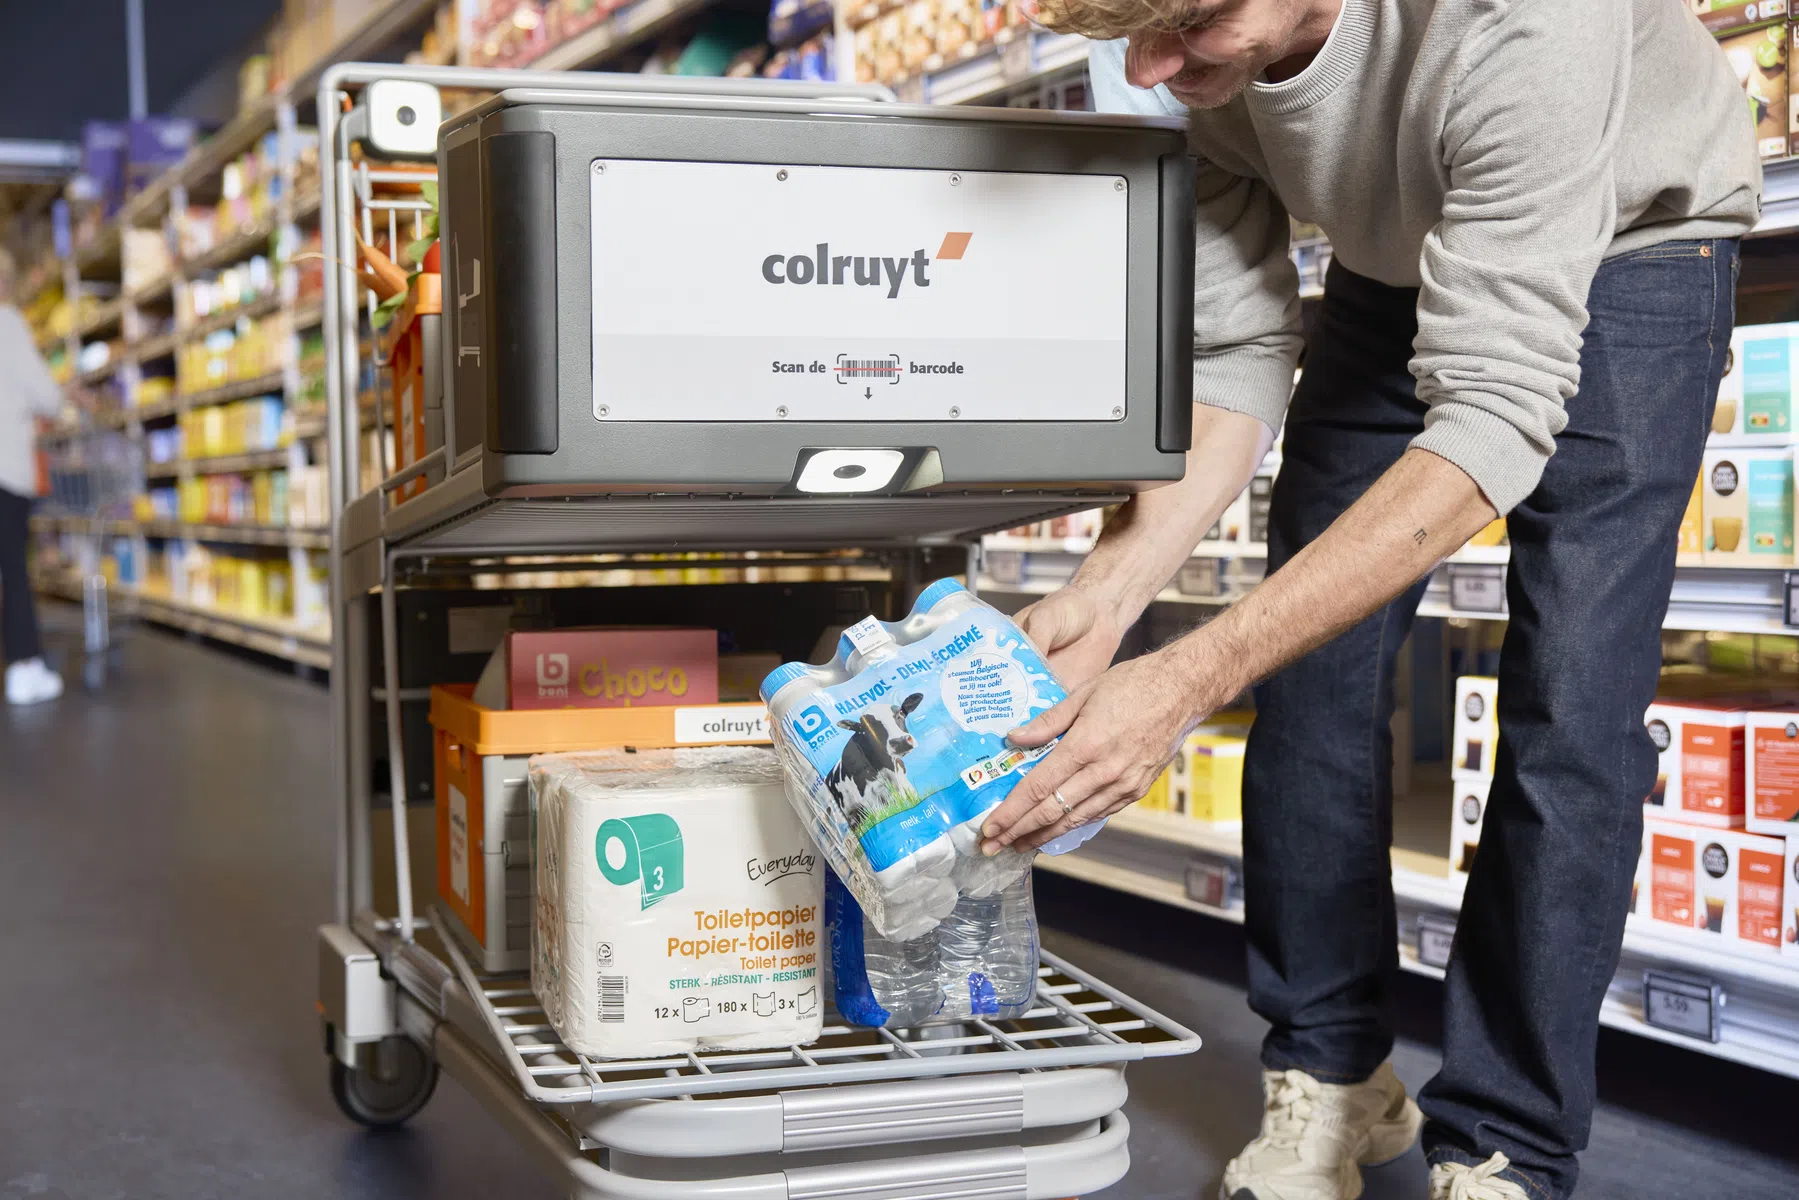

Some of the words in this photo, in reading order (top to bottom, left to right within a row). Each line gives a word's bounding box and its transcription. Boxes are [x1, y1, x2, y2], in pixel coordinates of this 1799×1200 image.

[761, 242, 930, 299] colruyt
[772, 361, 805, 373] Scan
[808, 361, 826, 373] de
[909, 361, 964, 374] barcode
[834, 679, 892, 715] HALFVOL
[896, 624, 984, 680] DEMI-ÉCRÉMÉ
[970, 658, 982, 668] Wij
[976, 662, 1009, 674] Belgische
[578, 656, 689, 700] Choco
[538, 685, 568, 697] boni
[957, 693, 974, 701] Nous
[975, 690, 1011, 699] soutenons
[970, 697, 1013, 707] producteurs
[703, 718, 762, 736] colruyt
[808, 725, 838, 750] boni
[900, 815, 921, 830] melk
[922, 803, 937, 819] lait
[747, 848, 816, 881] Everyday
[653, 865, 664, 891] 3
[694, 905, 816, 931] Toiletpapier
[667, 929, 816, 959] Papier-toilette
[739, 955, 777, 970] Toilet
[780, 952, 816, 970] paper
[669, 979, 700, 990] STERK
[711, 973, 763, 987] RÉSISTANT
[772, 967, 816, 983] RESISTANT
[654, 1007, 669, 1019] 12
[672, 1009, 680, 1018] x
[717, 1001, 737, 1013] 180
[740, 1003, 748, 1012] x
[778, 999, 785, 1010] 3
[788, 1000, 795, 1009] x
